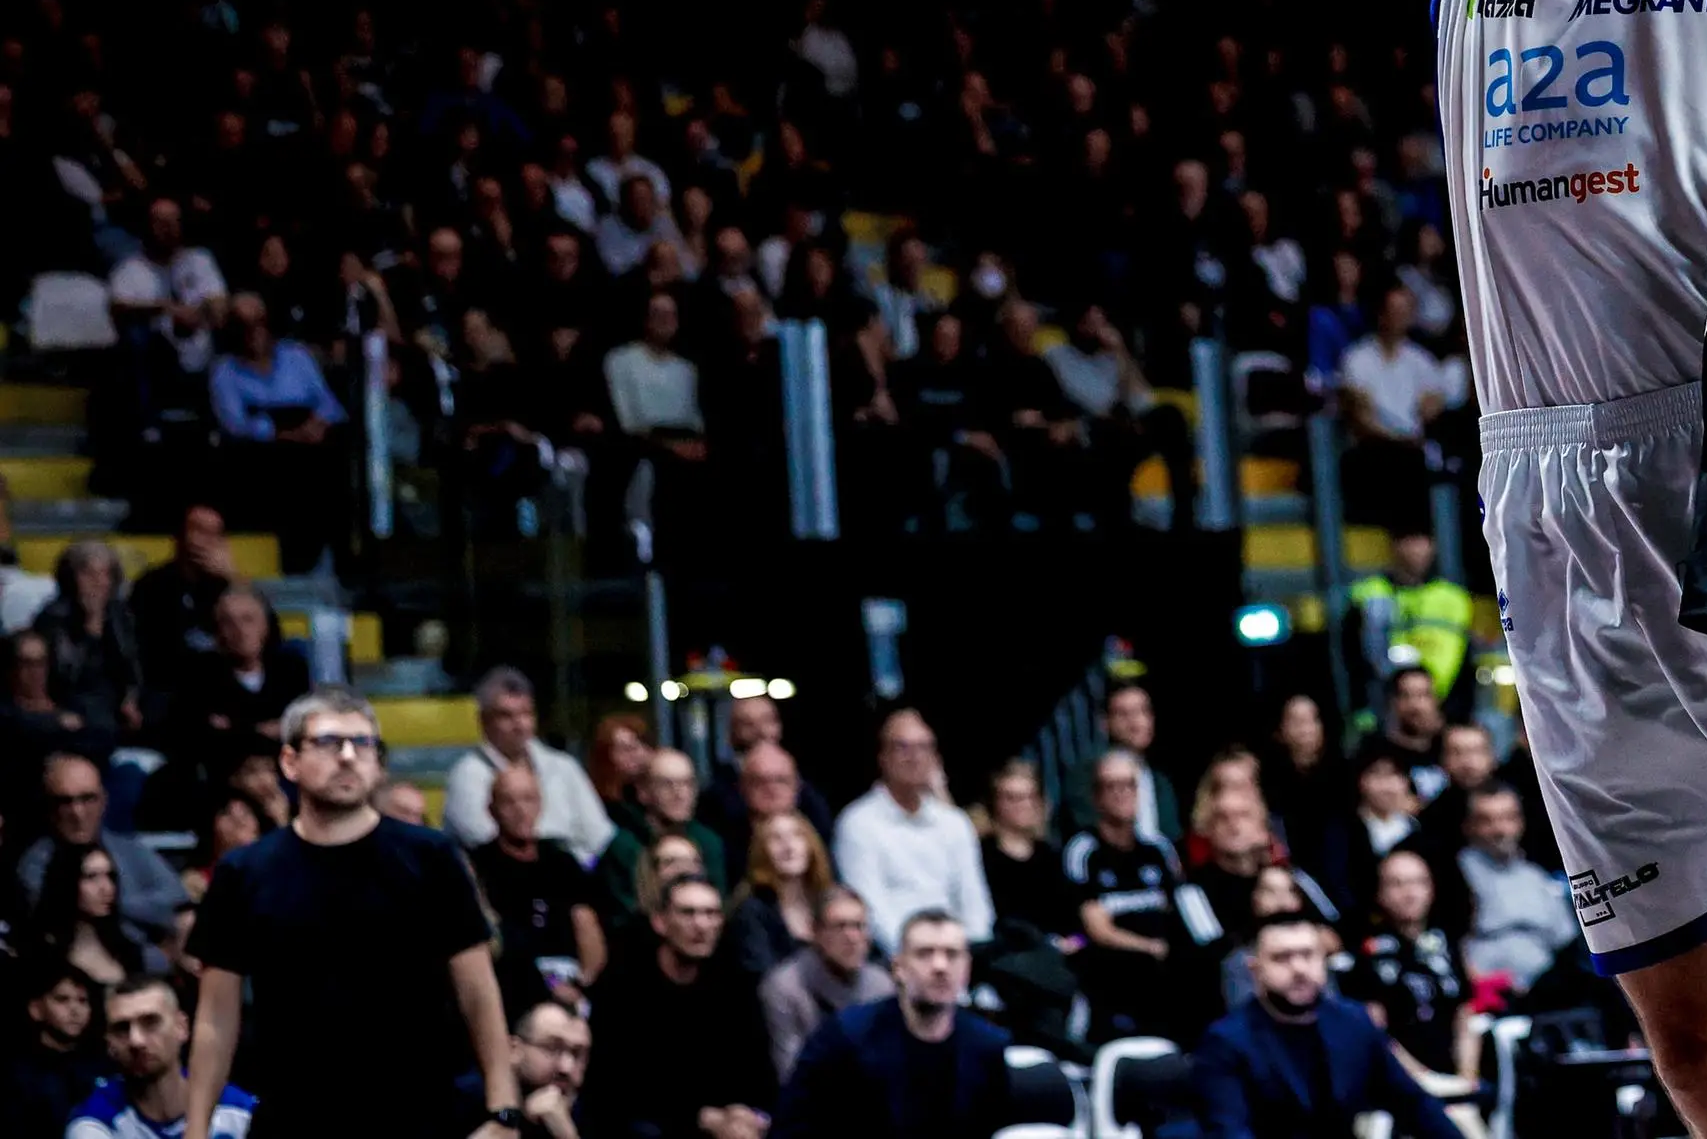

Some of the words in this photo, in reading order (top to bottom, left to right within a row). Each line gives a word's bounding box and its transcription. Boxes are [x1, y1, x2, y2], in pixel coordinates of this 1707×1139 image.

[1485, 40, 1630, 119] a2a
[1484, 126, 1513, 149] LIFE
[1517, 116, 1629, 142] COMPANY
[1479, 162, 1641, 211] Humangest
